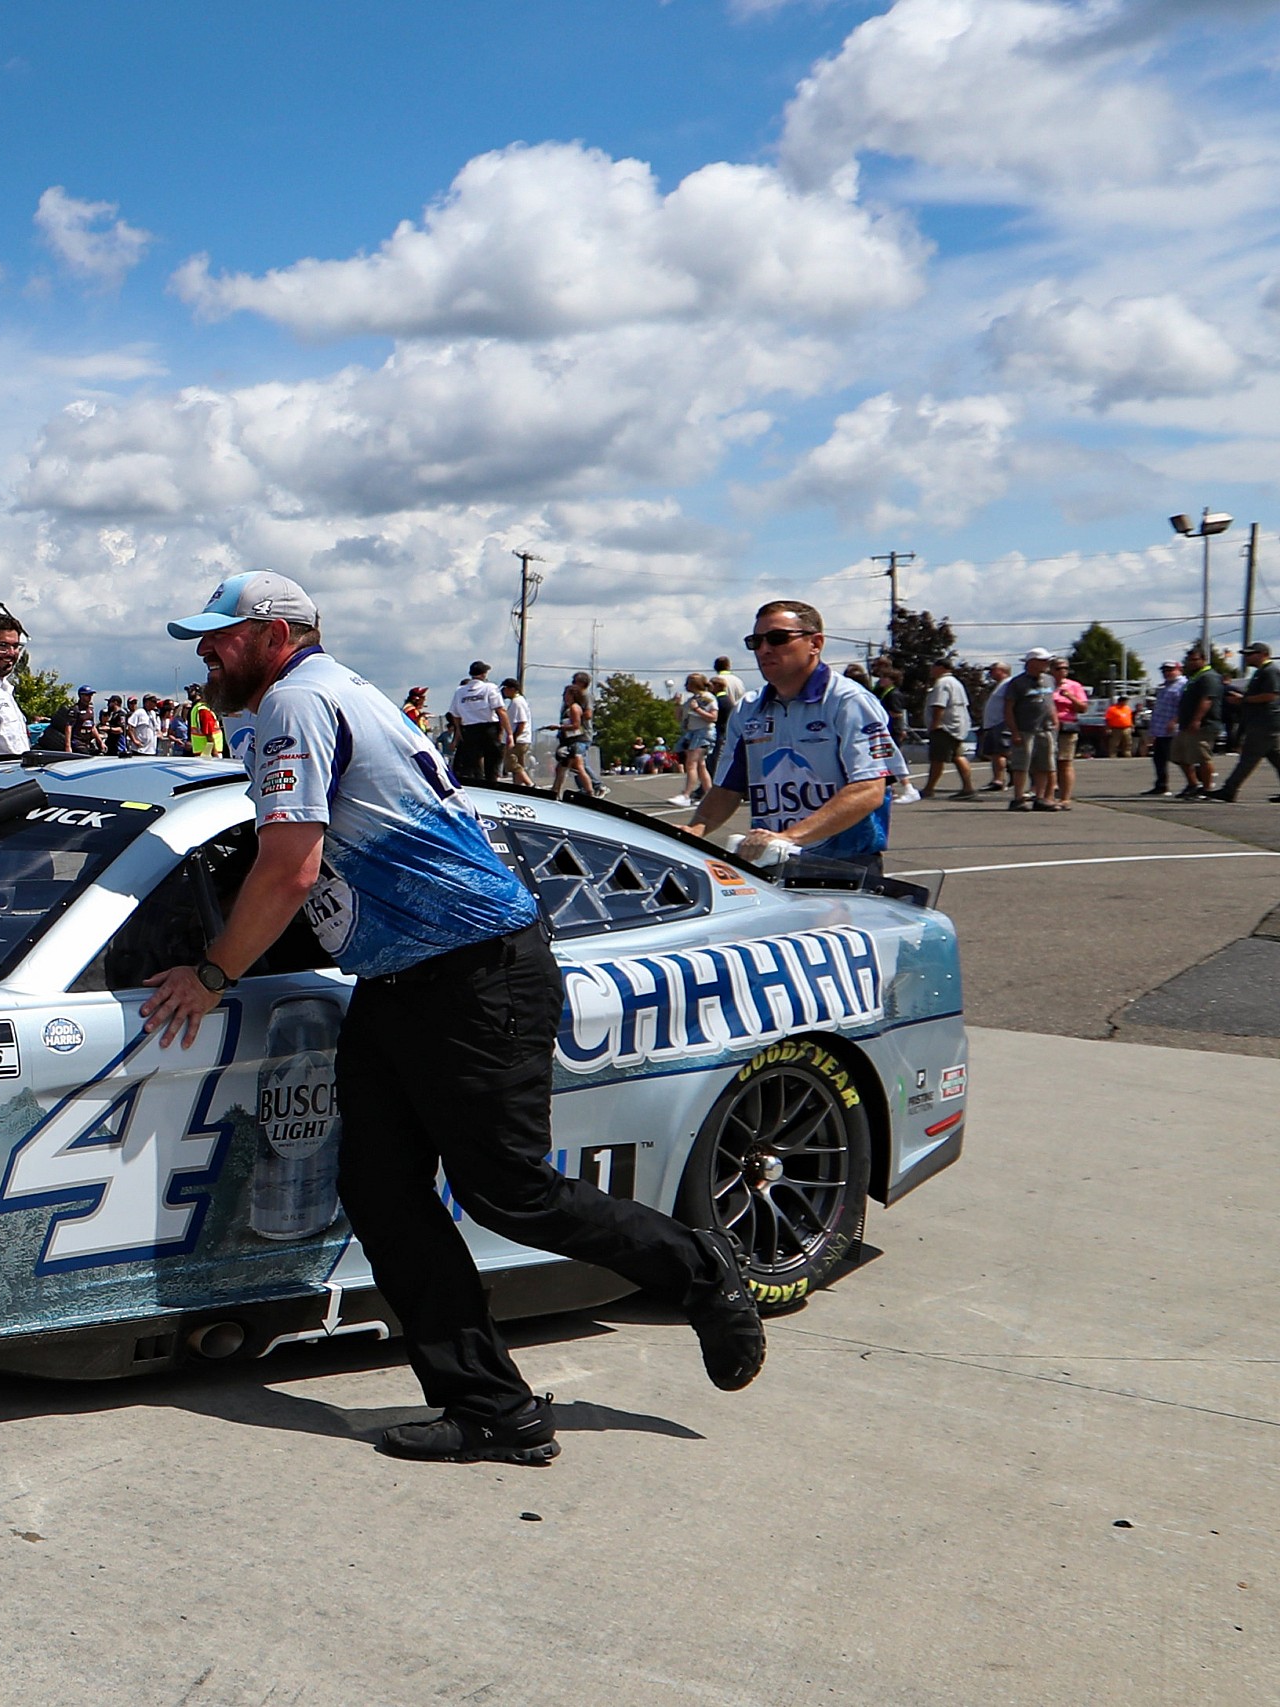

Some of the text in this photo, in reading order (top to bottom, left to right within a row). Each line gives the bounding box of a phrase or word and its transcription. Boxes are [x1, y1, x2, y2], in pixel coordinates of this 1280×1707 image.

[252, 600, 273, 616] 4
[50, 1024, 74, 1036] JODI
[45, 1034, 82, 1047] HARRIS
[260, 1083, 340, 1125] BUSCH
[272, 1120, 327, 1141] LIGHT
[593, 1148, 613, 1195] 1
